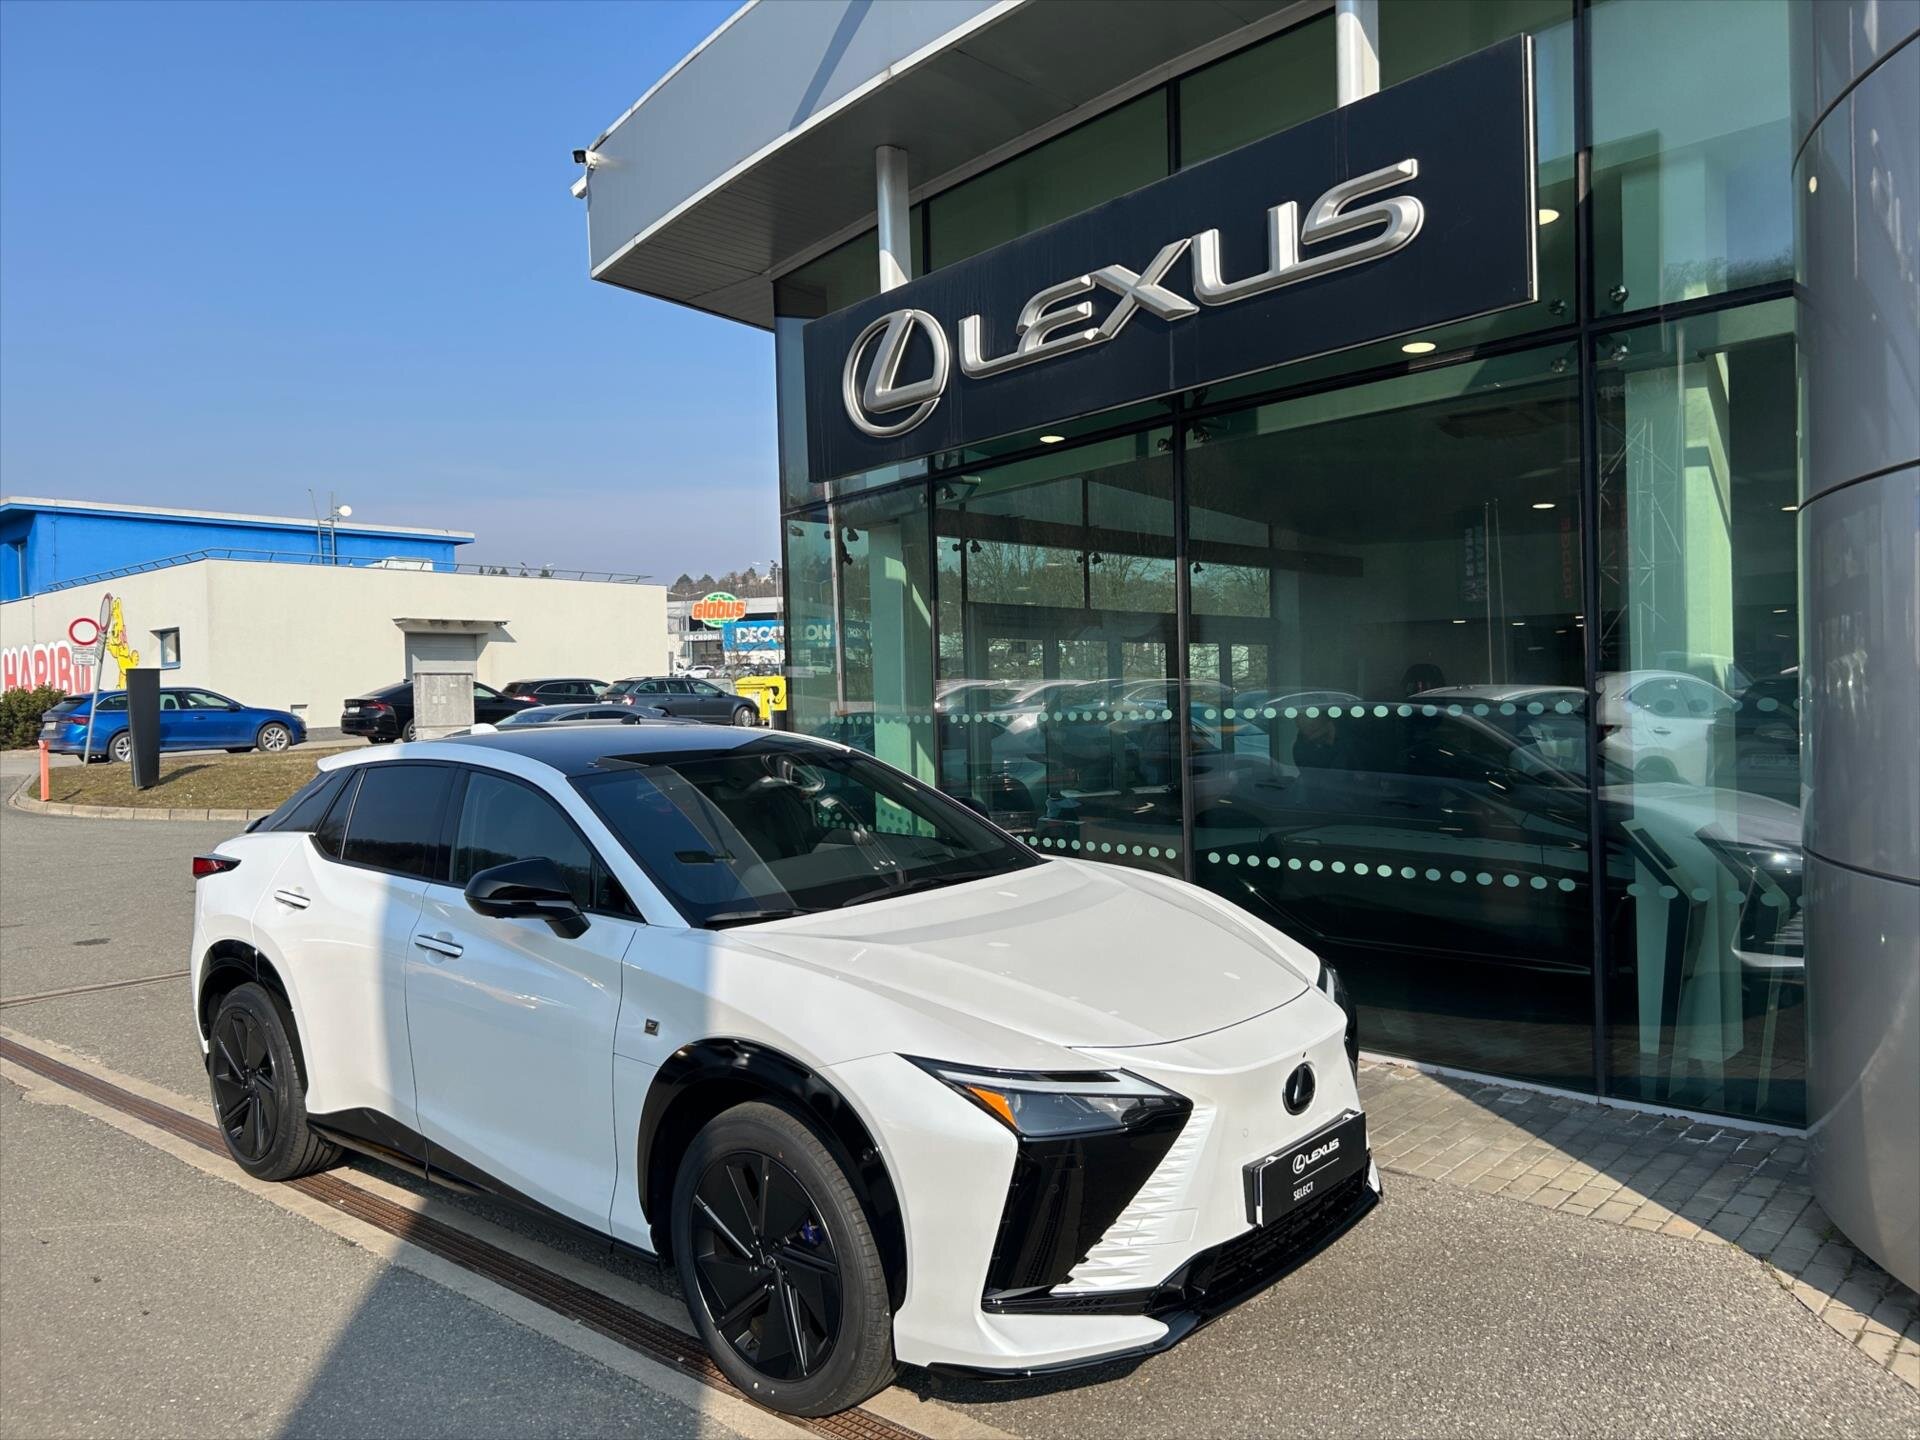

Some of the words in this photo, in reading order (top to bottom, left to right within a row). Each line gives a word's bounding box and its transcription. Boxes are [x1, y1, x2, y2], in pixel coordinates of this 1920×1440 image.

[958, 157, 1425, 379] LEXUS
[1306, 1138, 1340, 1165] LEXUS
[1293, 1181, 1314, 1201] SELECT
